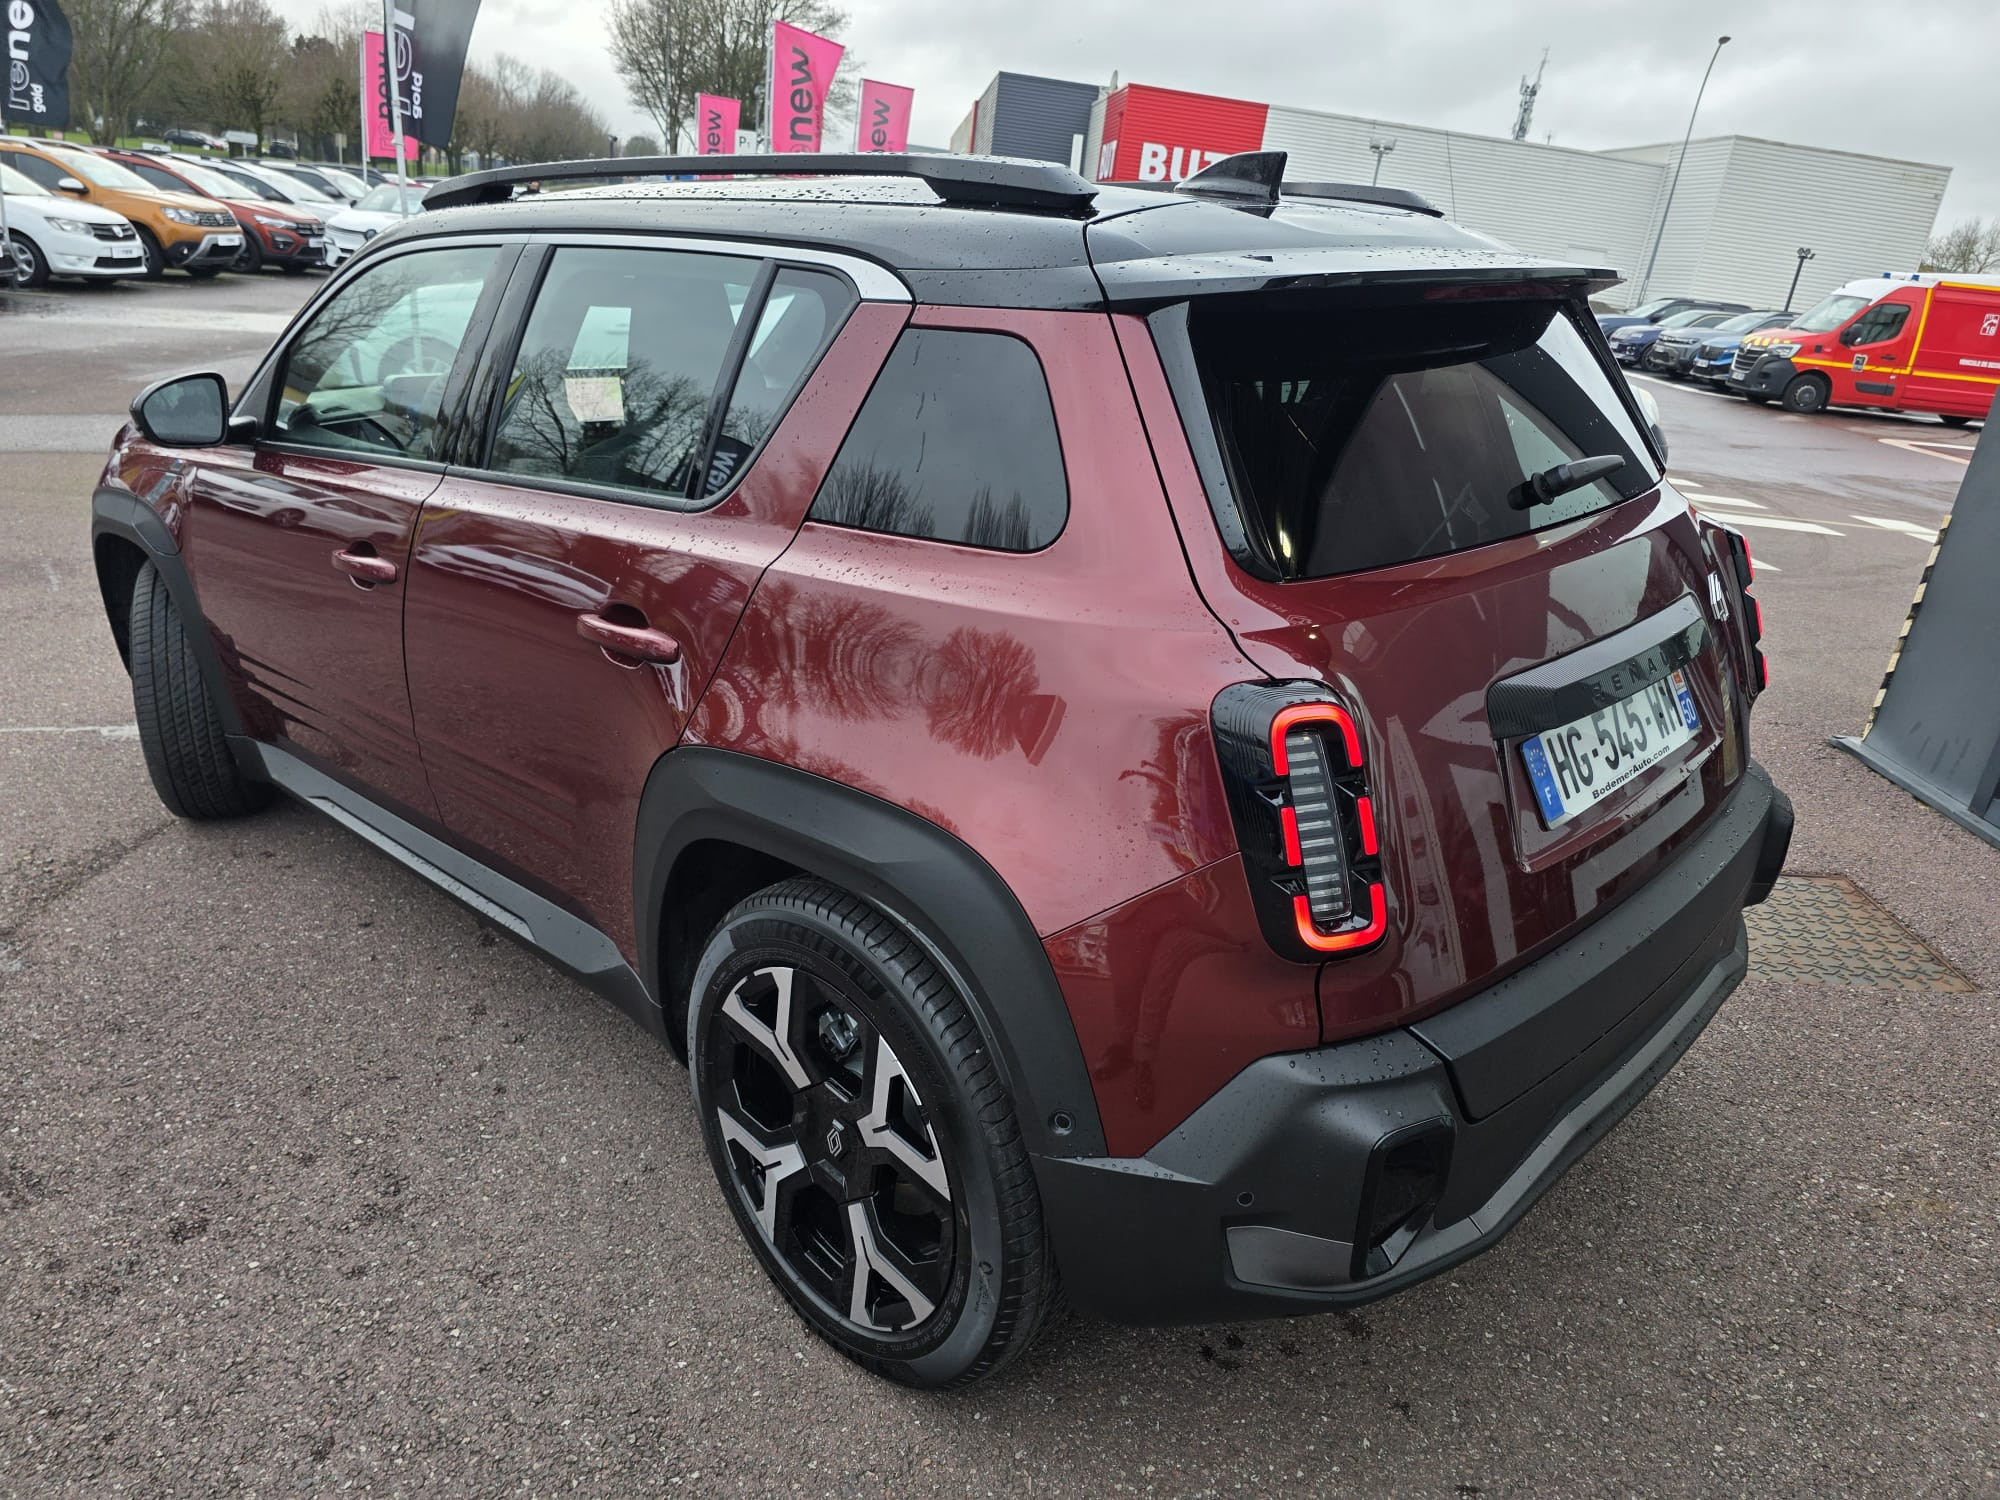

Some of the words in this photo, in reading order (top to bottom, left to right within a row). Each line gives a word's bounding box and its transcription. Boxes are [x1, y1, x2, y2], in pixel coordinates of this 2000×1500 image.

[30, 82, 47, 113] gold
[411, 72, 424, 119] gold
[871, 99, 891, 152] ew
[1592, 634, 1698, 701] RENAU
[1680, 697, 1697, 725] 50
[1592, 744, 1671, 799] BodemerAuto.com
[1543, 785, 1553, 806] F
